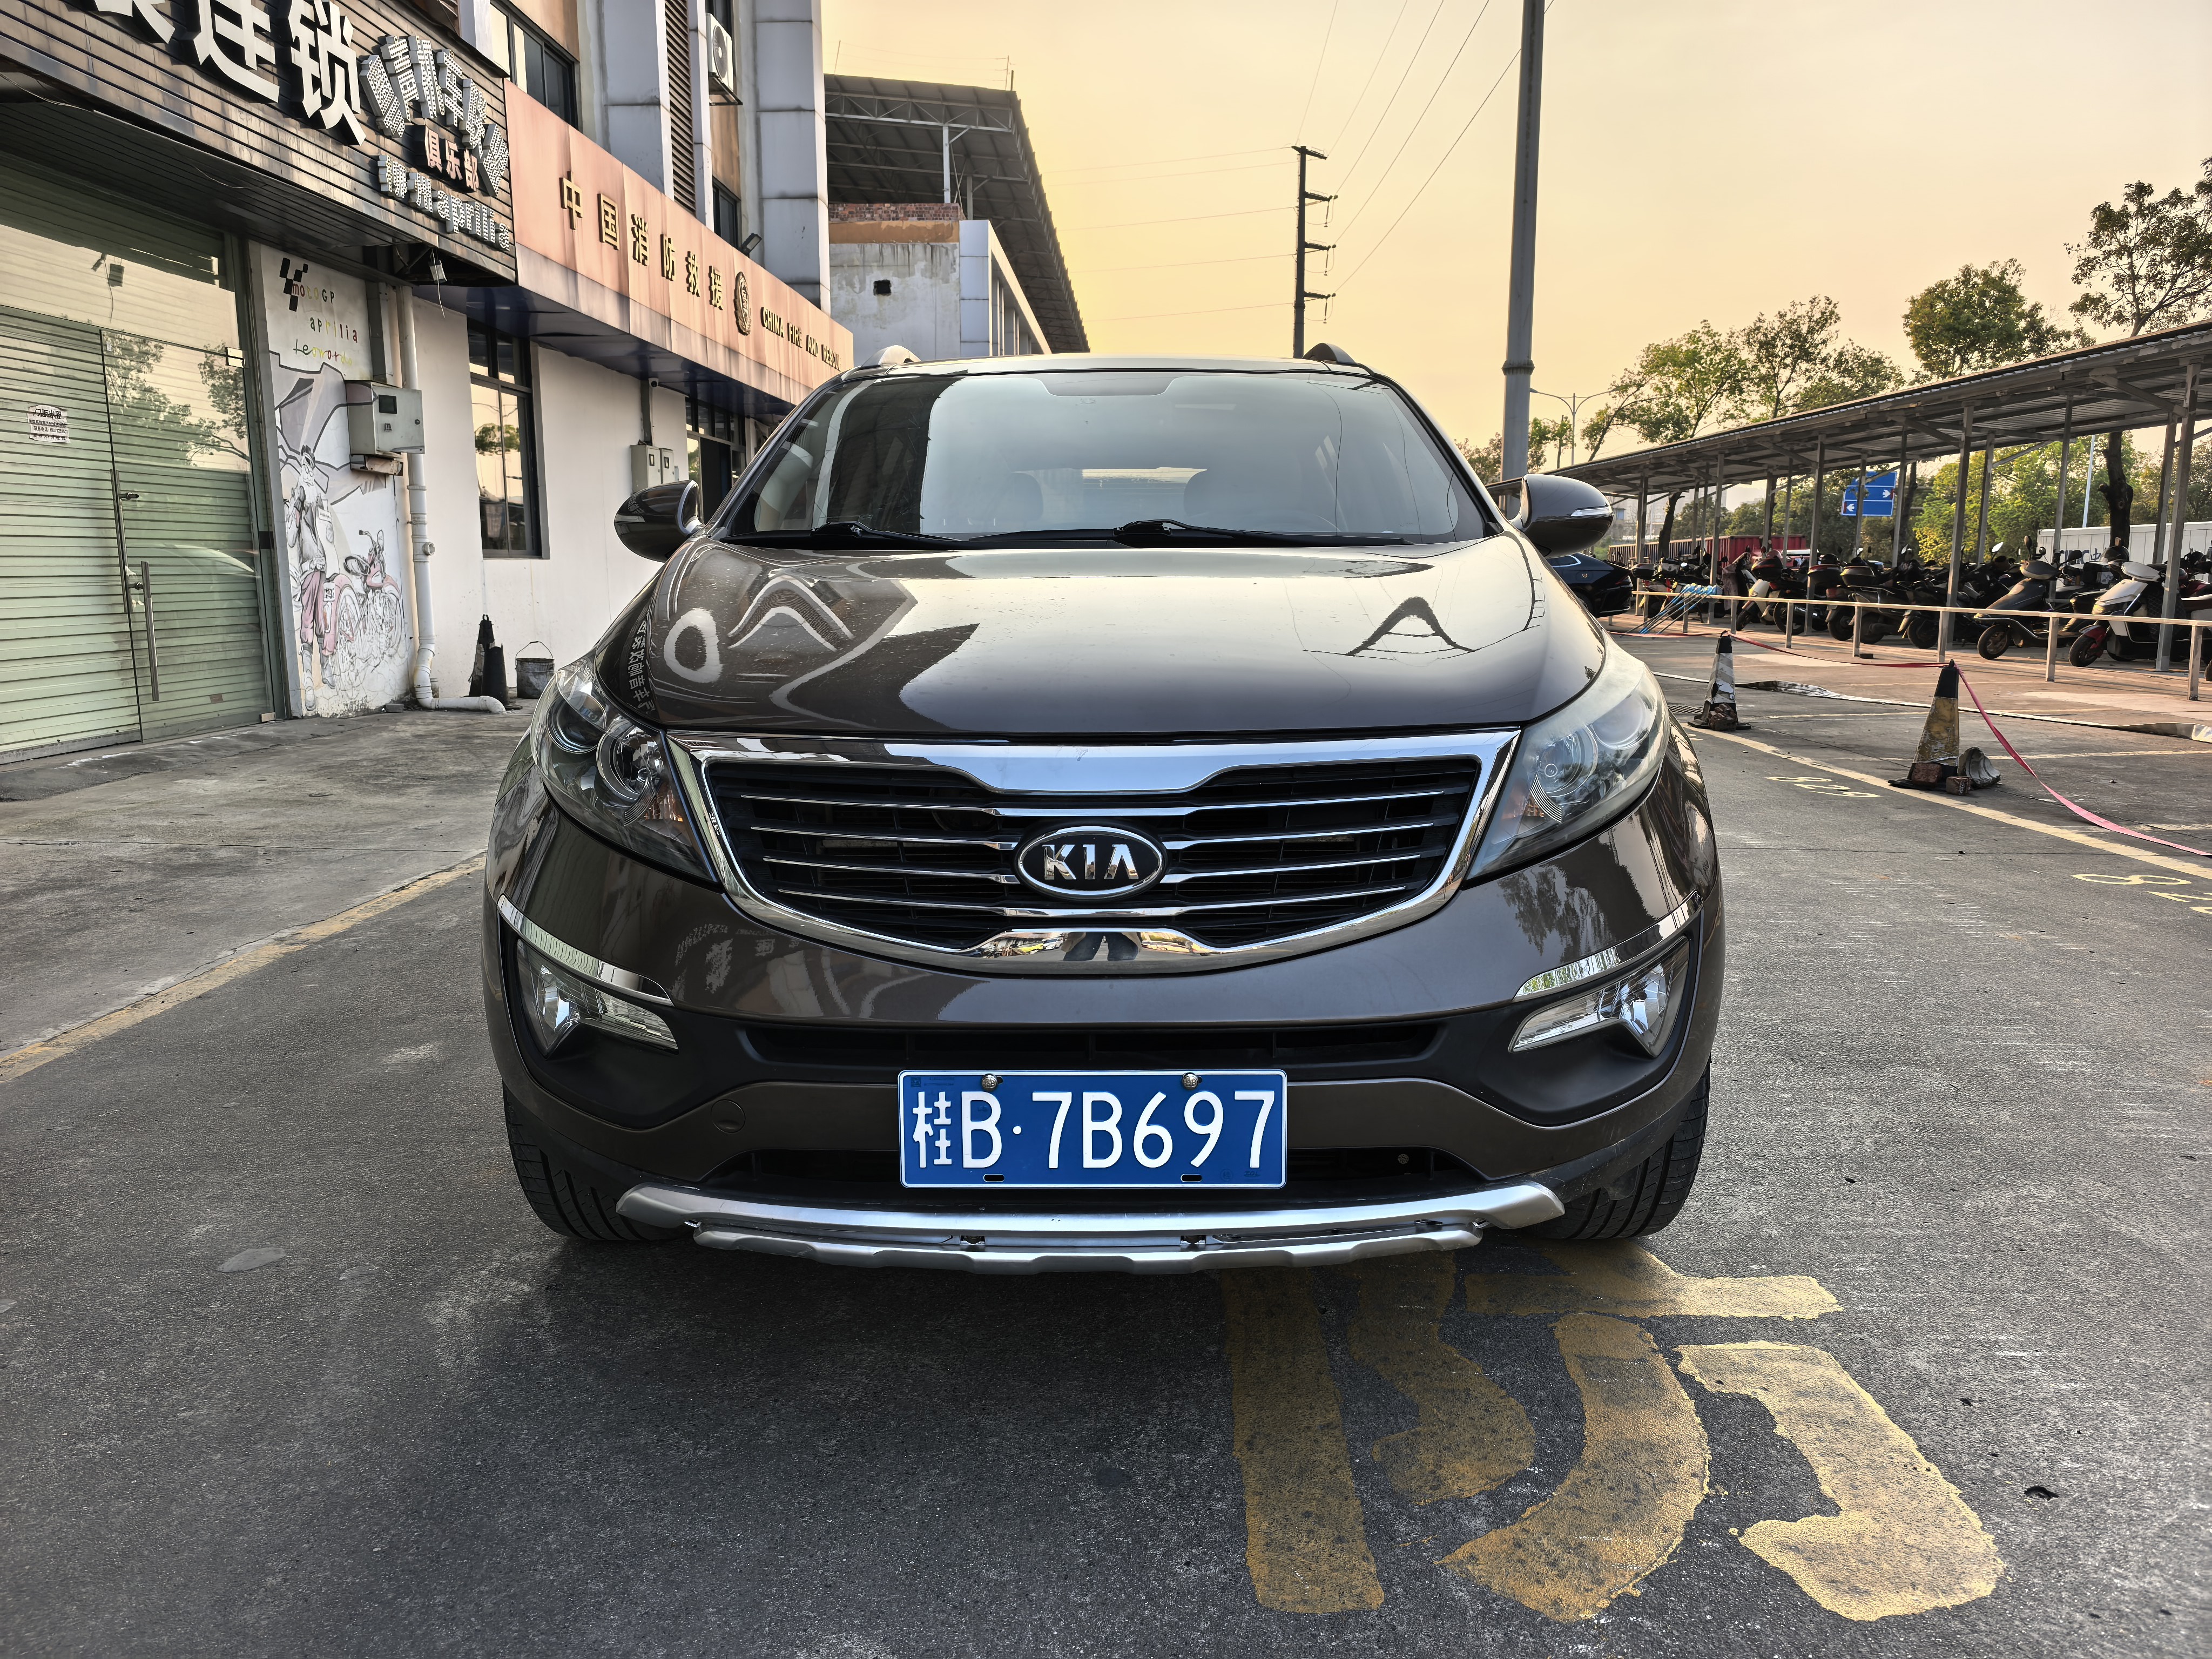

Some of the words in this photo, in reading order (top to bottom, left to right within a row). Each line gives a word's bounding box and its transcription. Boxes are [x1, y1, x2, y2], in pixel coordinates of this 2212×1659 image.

[94, 0, 367, 146] 连锁
[424, 125, 480, 192] 俱乐部
[559, 171, 724, 311] 中国消防救援
[292, 283, 335, 304] motoGP
[310, 317, 358, 343] aprilia
[761, 307, 784, 338] CHINA
[787, 323, 802, 348] FIRE
[807, 335, 818, 357] AND
[1042, 844, 1139, 880] KIA
[912, 1091, 1275, 1169] 桂B·7B697
